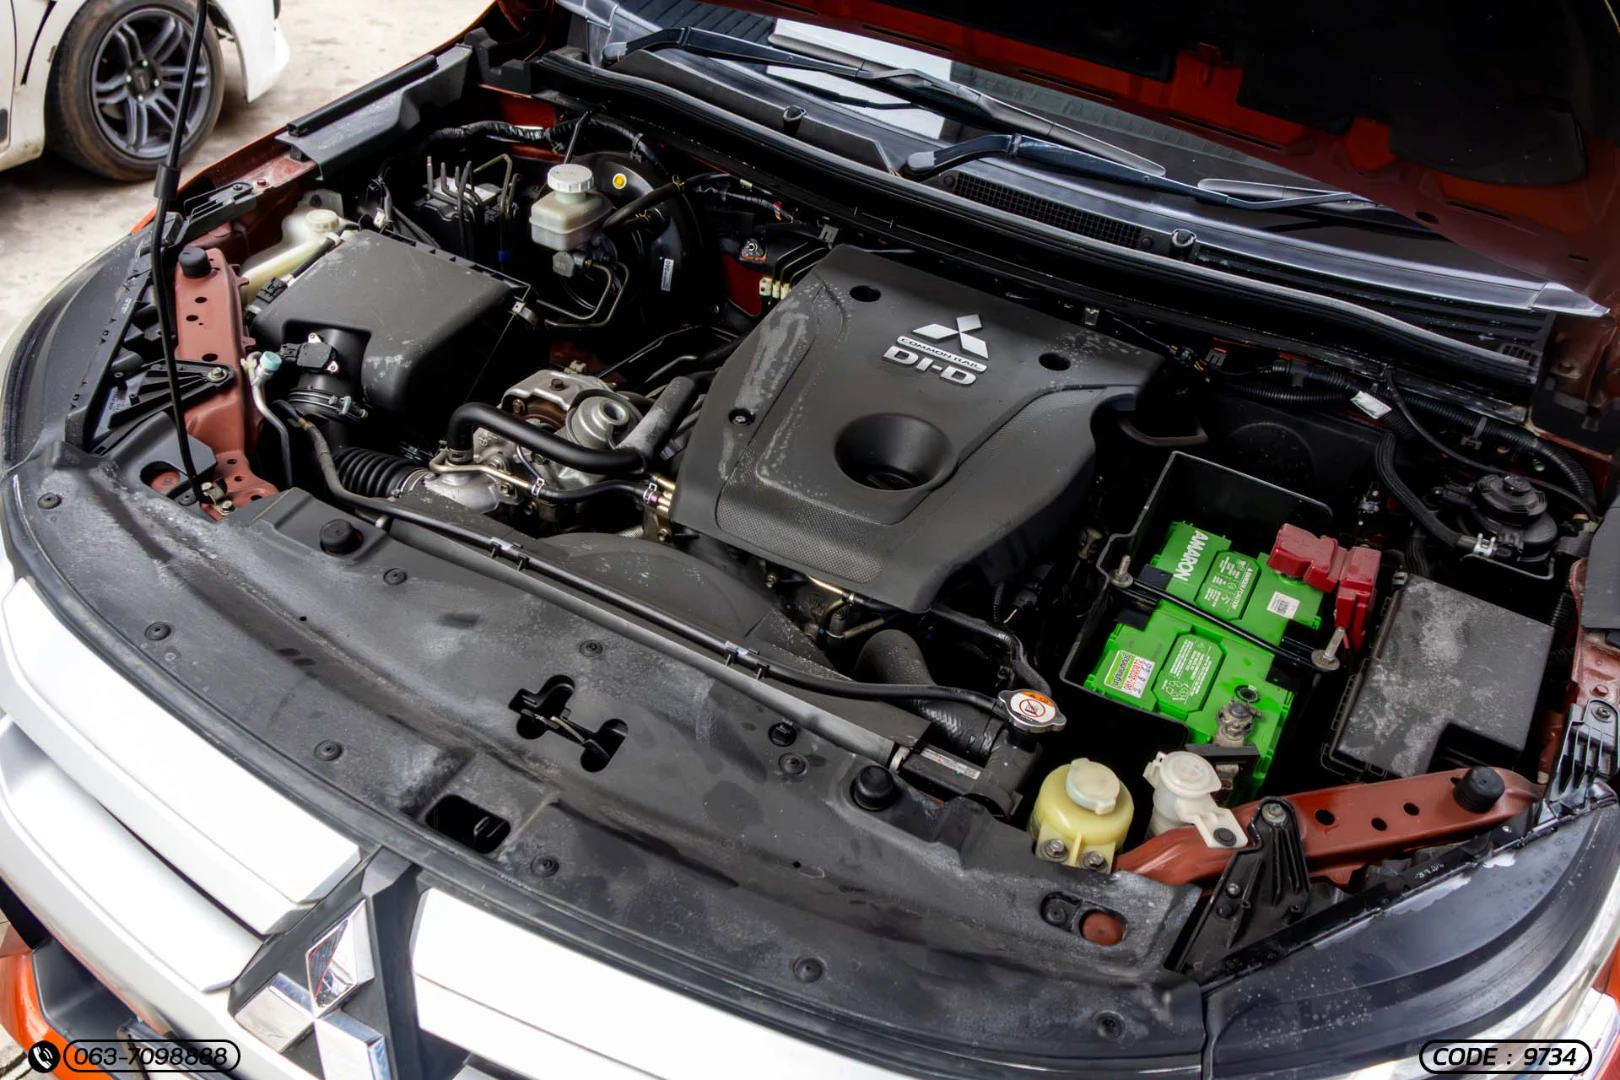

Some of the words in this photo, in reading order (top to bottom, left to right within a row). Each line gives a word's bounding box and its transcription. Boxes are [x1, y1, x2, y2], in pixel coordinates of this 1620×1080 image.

[883, 345, 977, 385] DI-D
[901, 337, 952, 360] COMMON
[953, 358, 981, 370] RAIL
[1173, 530, 1209, 582] AMARON
